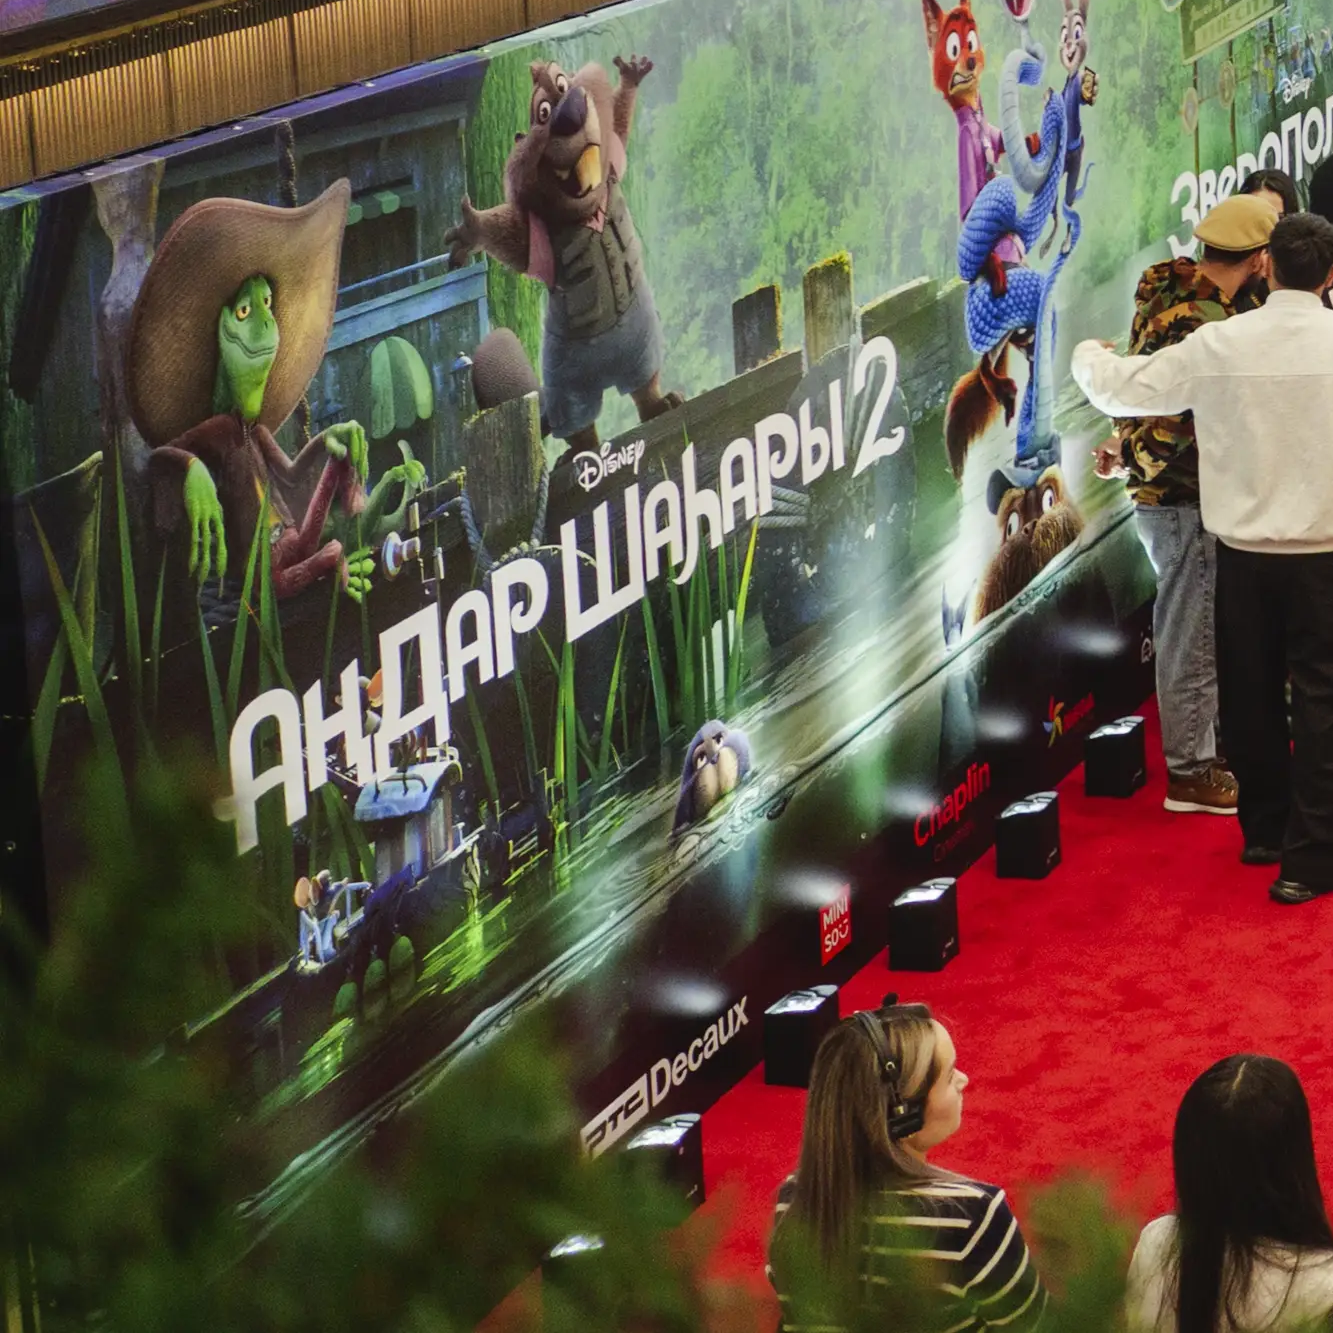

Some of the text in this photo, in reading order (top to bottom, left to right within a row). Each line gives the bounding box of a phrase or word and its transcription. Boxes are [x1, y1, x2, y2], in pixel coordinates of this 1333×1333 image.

[229, 557, 549, 856] АНДАР
[851, 335, 905, 480] 2
[914, 762, 990, 847] Chaplin
[823, 895, 848, 931] MINI
[650, 994, 749, 1108] Decaux
